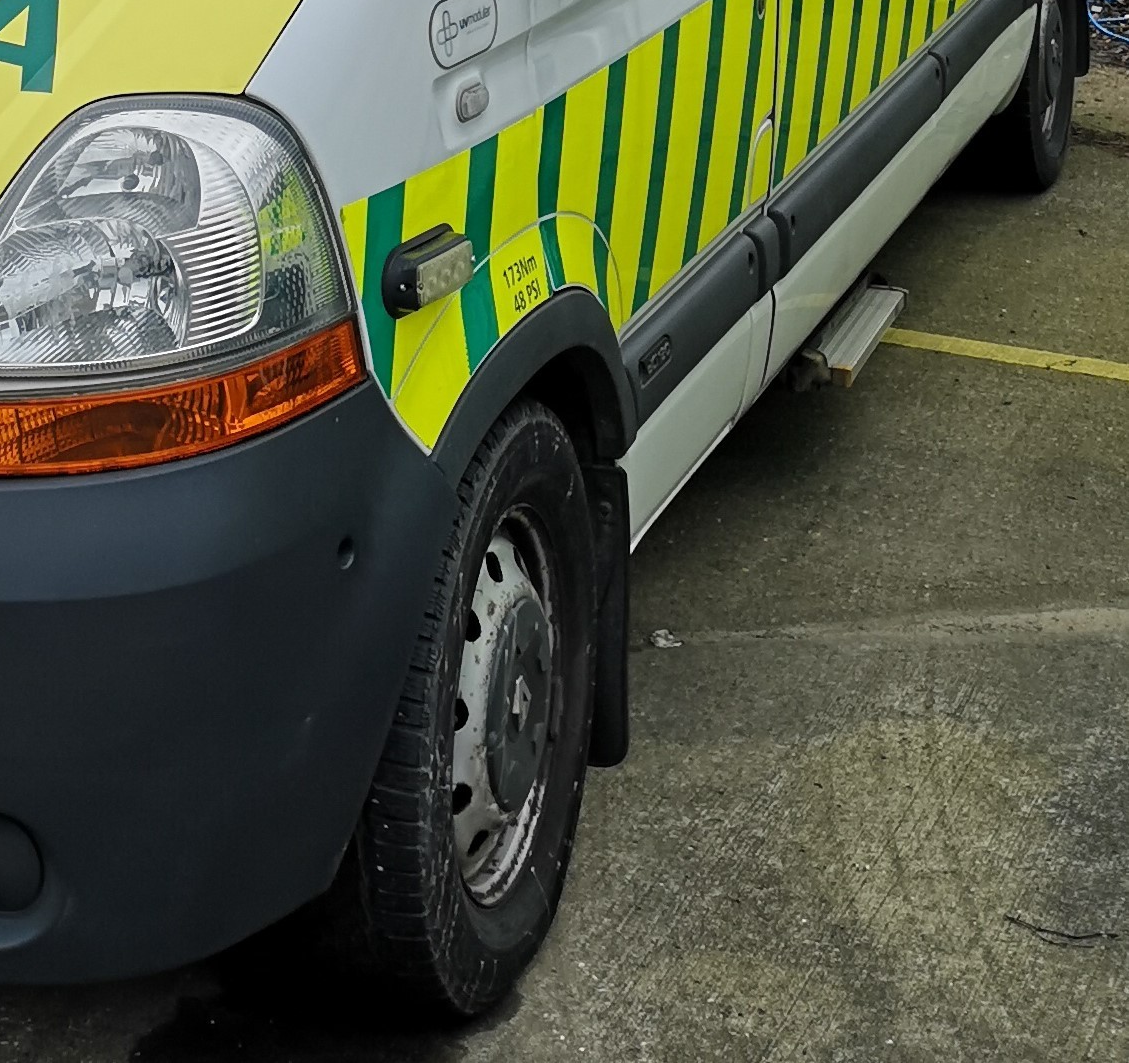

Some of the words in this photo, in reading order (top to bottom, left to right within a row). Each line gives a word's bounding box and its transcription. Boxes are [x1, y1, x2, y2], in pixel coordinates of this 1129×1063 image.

[503, 255, 537, 289] 173Nm
[514, 290, 527, 314] 48
[526, 277, 541, 304] PSI
